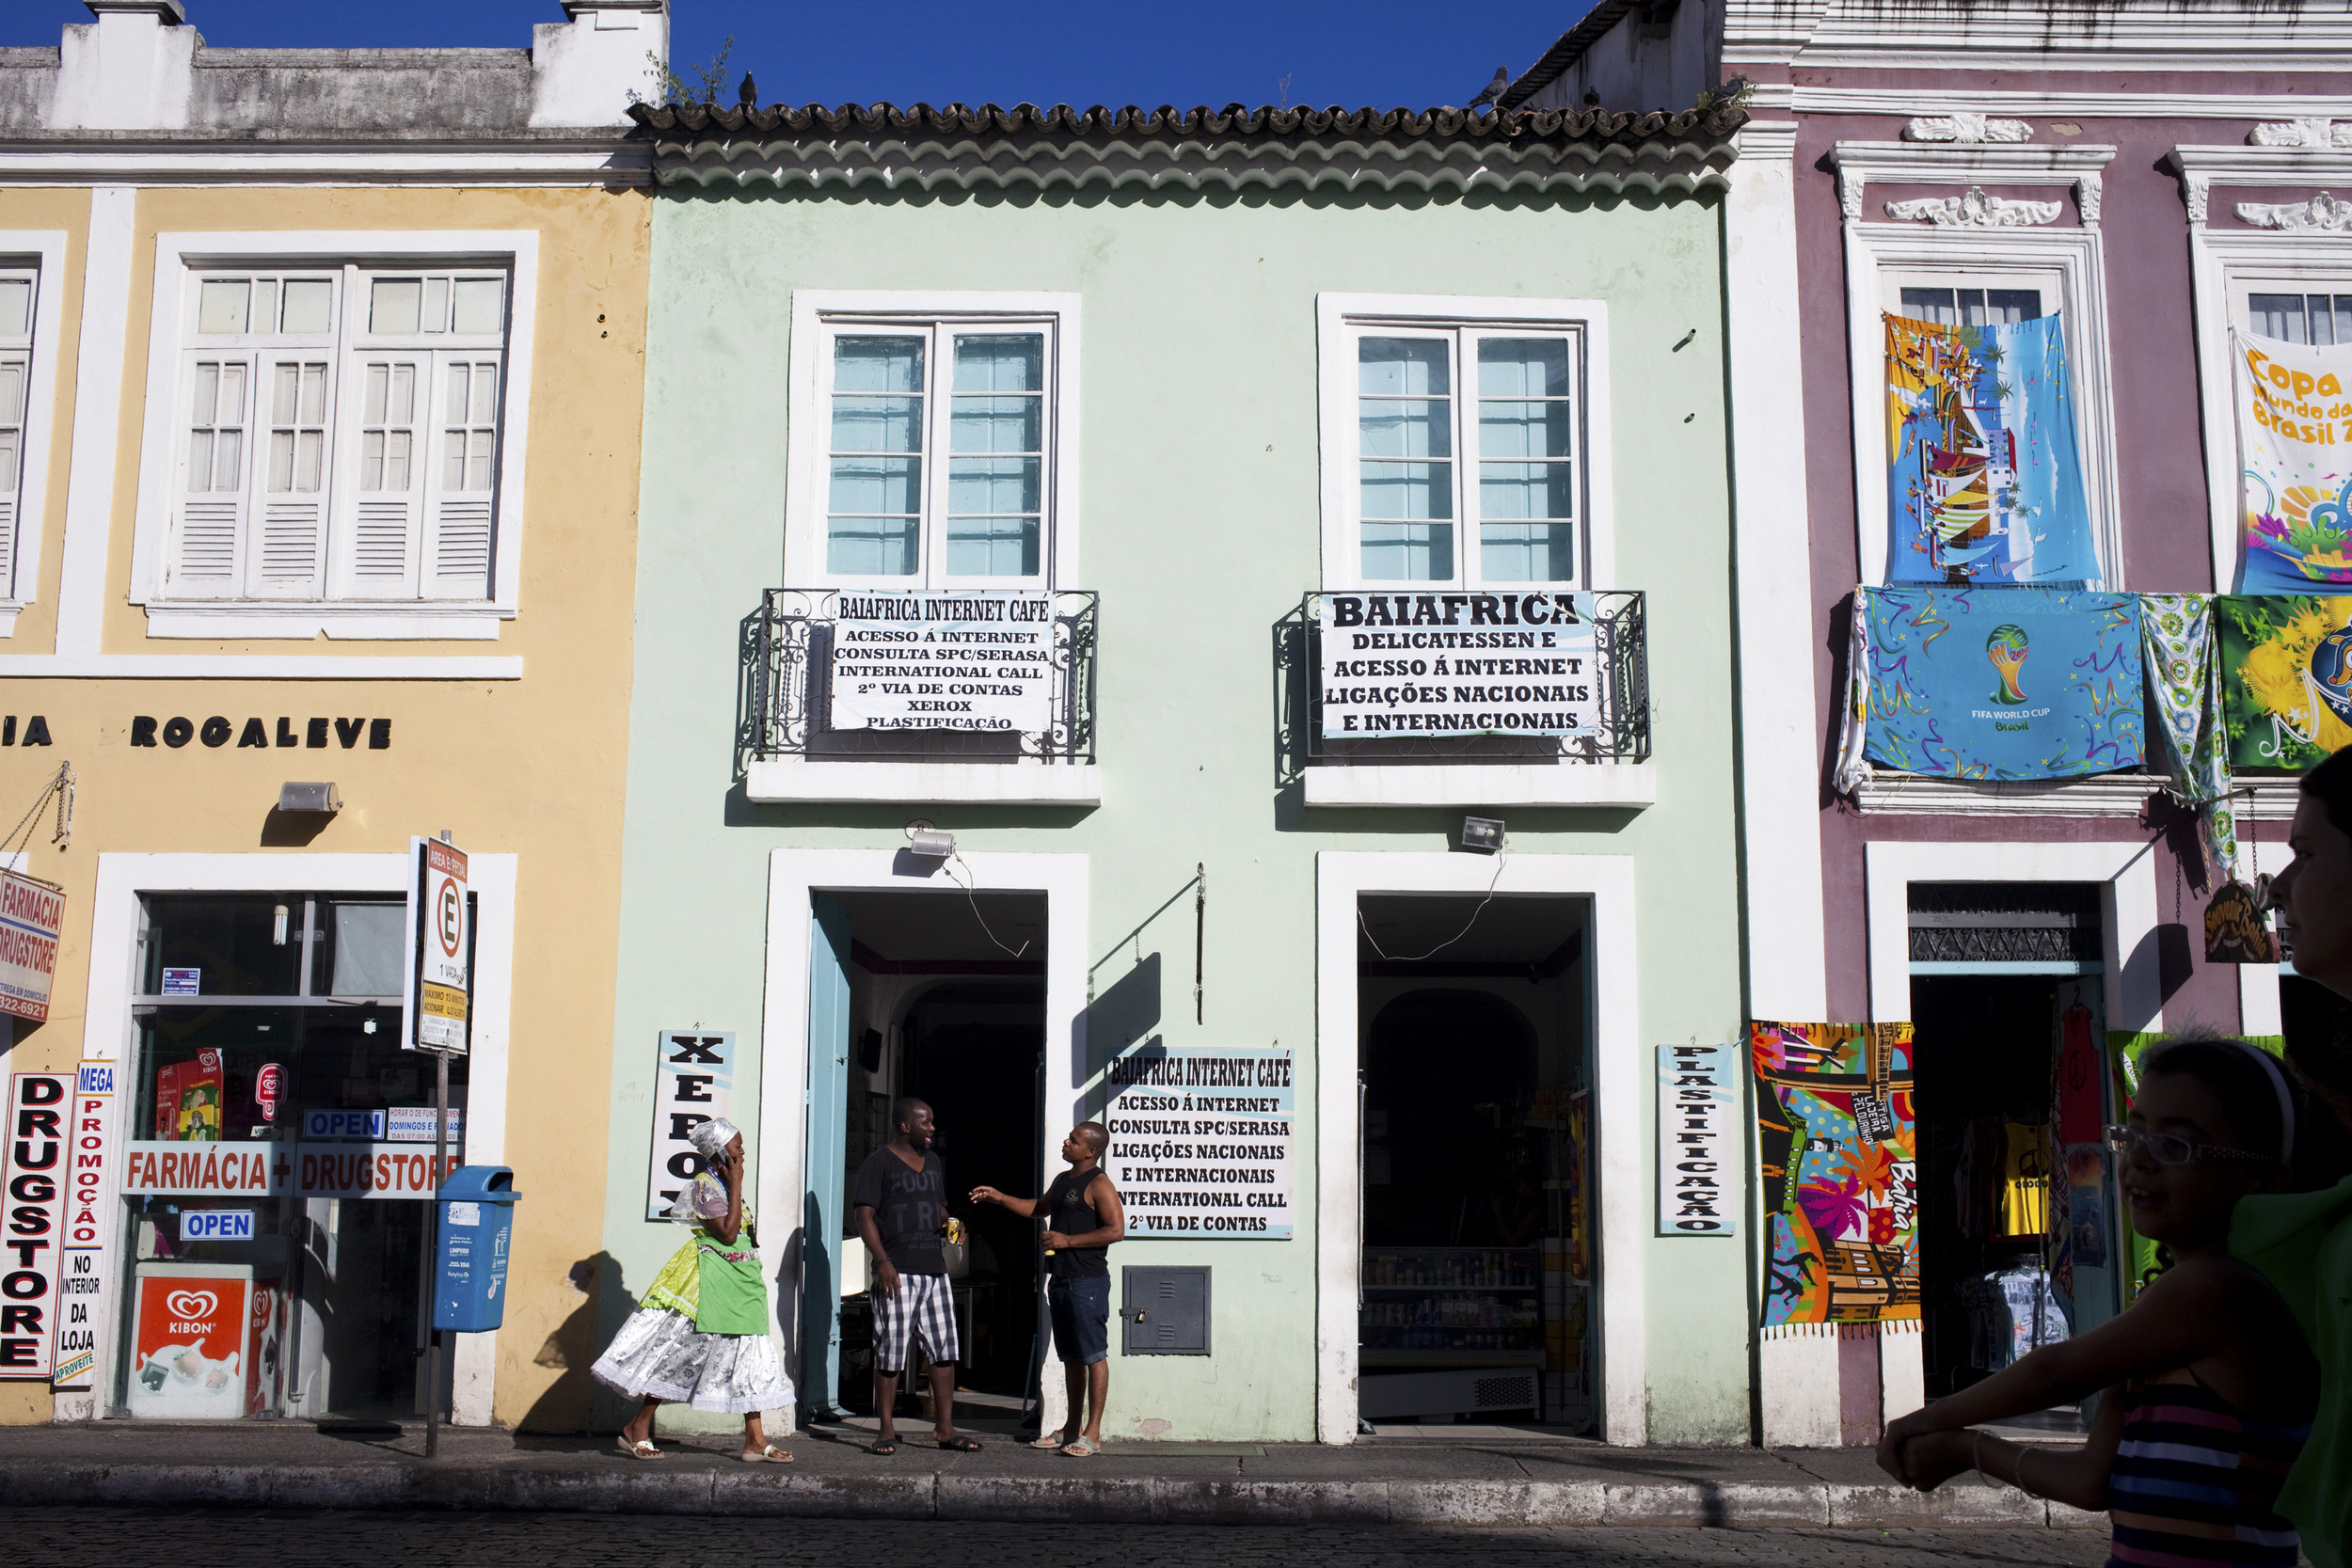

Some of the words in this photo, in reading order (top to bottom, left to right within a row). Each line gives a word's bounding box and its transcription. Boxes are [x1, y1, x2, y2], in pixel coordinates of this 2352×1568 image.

[2248, 349, 2343, 401] Copa
[2253, 383, 2323, 420] Mundo
[2328, 403, 2352, 419] da
[2253, 400, 2335, 445] Brasil
[839, 597, 921, 622] BAIAFRICA
[925, 599, 1005, 622] INTERNET
[1009, 593, 1049, 622] CAFÉ
[1332, 594, 1581, 627] BAIAFRICA
[845, 630, 918, 642] ACESSO
[924, 628, 937, 642] Á
[942, 631, 1039, 643] INTERNET
[1353, 632, 1534, 649] DELICATESSEN
[1541, 632, 1556, 648] E
[834, 648, 931, 660] CONSULTA
[935, 648, 1050, 662] SPC/SERASA
[838, 665, 992, 678] INTERNATIONAL
[997, 667, 1042, 679] CALL
[1334, 658, 1426, 677] ACESSO
[1433, 655, 1450, 675] Á
[1455, 658, 1581, 675] INTERNET
[881, 683, 913, 694] VIA
[917, 684, 942, 694] DE
[948, 684, 1023, 696] CONTAS
[1325, 682, 1448, 707] LIGAÇÕES
[1454, 685, 1588, 703] NACIONAIS
[907, 700, 972, 712] XEROX
[1972, 710, 1993, 719] FIFA
[1994, 710, 2029, 719] WORLD
[2031, 707, 2050, 717] CUP
[866, 716, 1012, 731] PLASTIFICAÇÃO
[1343, 714, 1358, 731] E
[1364, 712, 1578, 731] INTERNACIONAIS
[1995, 721, 2029, 731] Brasil
[2, 716, 53, 747] IA
[130, 716, 391, 750] ROGALEVE
[431, 847, 446, 868] ÁREA
[2, 882, 60, 930] FARMÁCIA
[2205, 892, 2243, 940] Souvenir
[445, 892, 455, 942] E
[439, 964, 444, 975] 1
[0, 982, 15, 995] TREGA
[16, 987, 24, 997] EM
[24, 990, 47, 1002] DOMICILIO
[424, 987, 444, 1000] MÁXIMO
[446, 992, 452, 1002] 15
[0, 996, 46, 1018] 322-6921
[424, 1002, 444, 1014] ACIONAR
[1111, 1056, 1184, 1086] BAIAFRICA
[1186, 1057, 1254, 1087] INTERNET
[1257, 1050, 1291, 1087] CAFÉ
[79, 1068, 113, 1092] MEGA
[1118, 1096, 1179, 1111] ACESSO
[1183, 1093, 1193, 1111] Á
[1197, 1098, 1279, 1113] INTERNET
[310, 1114, 379, 1135] OPEN
[389, 1122, 426, 1131] DOMINGOS
[435, 1122, 466, 1131] FIADOS
[1108, 1119, 1190, 1134] CONSULTA
[1194, 1120, 1290, 1136] SPC/SERASA
[1673, 1046, 1721, 1231] PLASTIFICAÇÃO
[1112, 1140, 1193, 1162] LIGAÇÕES
[1196, 1145, 1284, 1160] NACIONAIS
[73, 1101, 103, 1241] PROMOÇÃO
[127, 1145, 266, 1189] FARMÁCIA
[1121, 1167, 1132, 1181] E
[1136, 1168, 1275, 1183] INTERNACIONAIS
[1118, 1192, 1243, 1207] NTERNATIONAL
[1247, 1193, 1287, 1208] CALL
[1888, 1161, 1917, 1230] Bahia
[0, 1077, 64, 1368] DRUGSTORE
[188, 1215, 249, 1236] OPEN
[1146, 1216, 1173, 1230] VIA
[1177, 1216, 1199, 1230] DE
[1202, 1217, 1266, 1231] CONTAS
[73, 1256, 91, 1274] NO
[62, 1277, 100, 1294] INTERIOR
[71, 1303, 87, 1323] DA
[169, 1322, 212, 1334] KIBON
[61, 1330, 94, 1351] LOJA
[56, 1354, 93, 1381] APROVEITE
